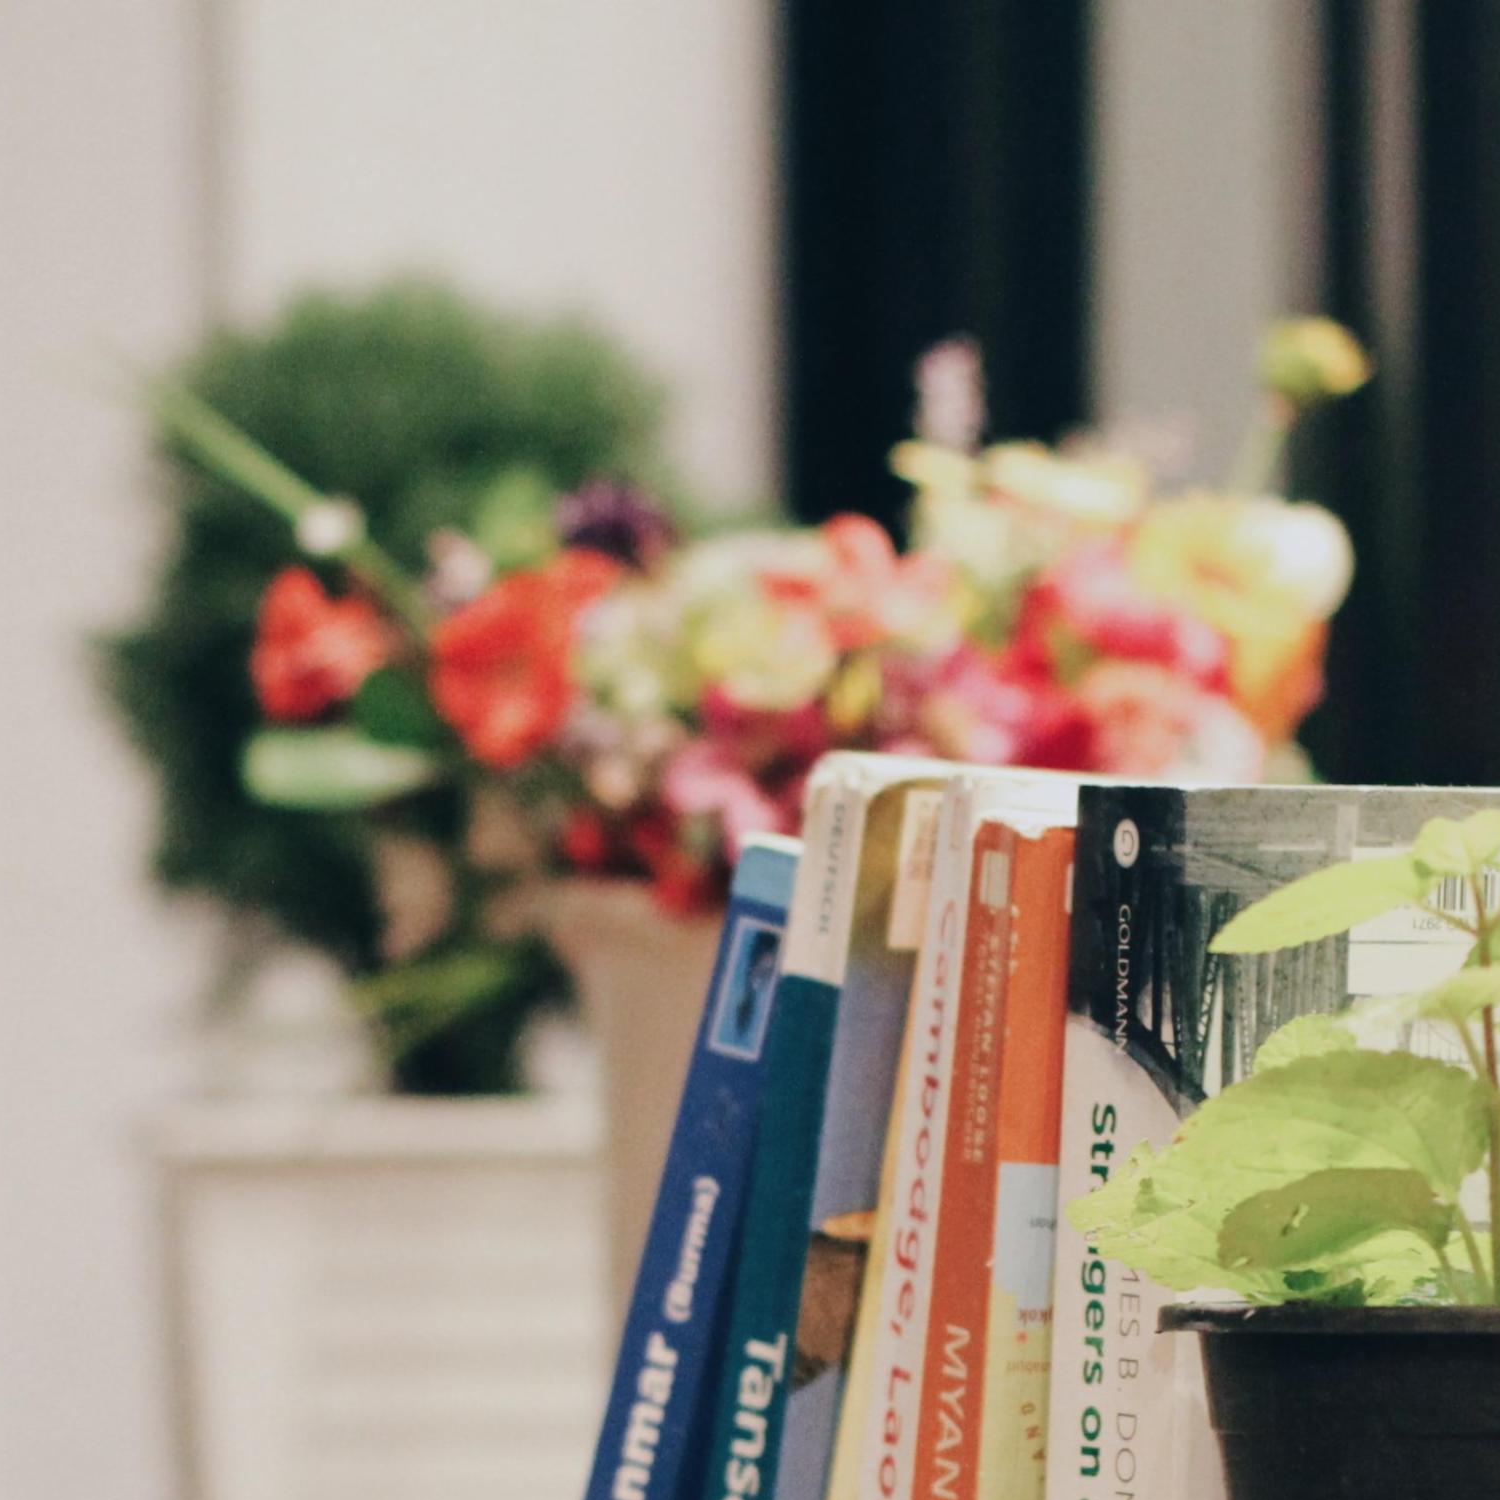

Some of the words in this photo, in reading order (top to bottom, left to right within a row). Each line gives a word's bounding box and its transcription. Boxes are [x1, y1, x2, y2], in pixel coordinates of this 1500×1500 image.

[818, 803, 846, 937] DEUTSCH
[1115, 903, 1133, 1056] GOLDMANN
[662, 1174, 721, 1323] (Burma)
[1081, 1103, 1117, 1385] Strgers
[1078, 1406, 1103, 1478] on
[1116, 1357, 1140, 1392] B.
